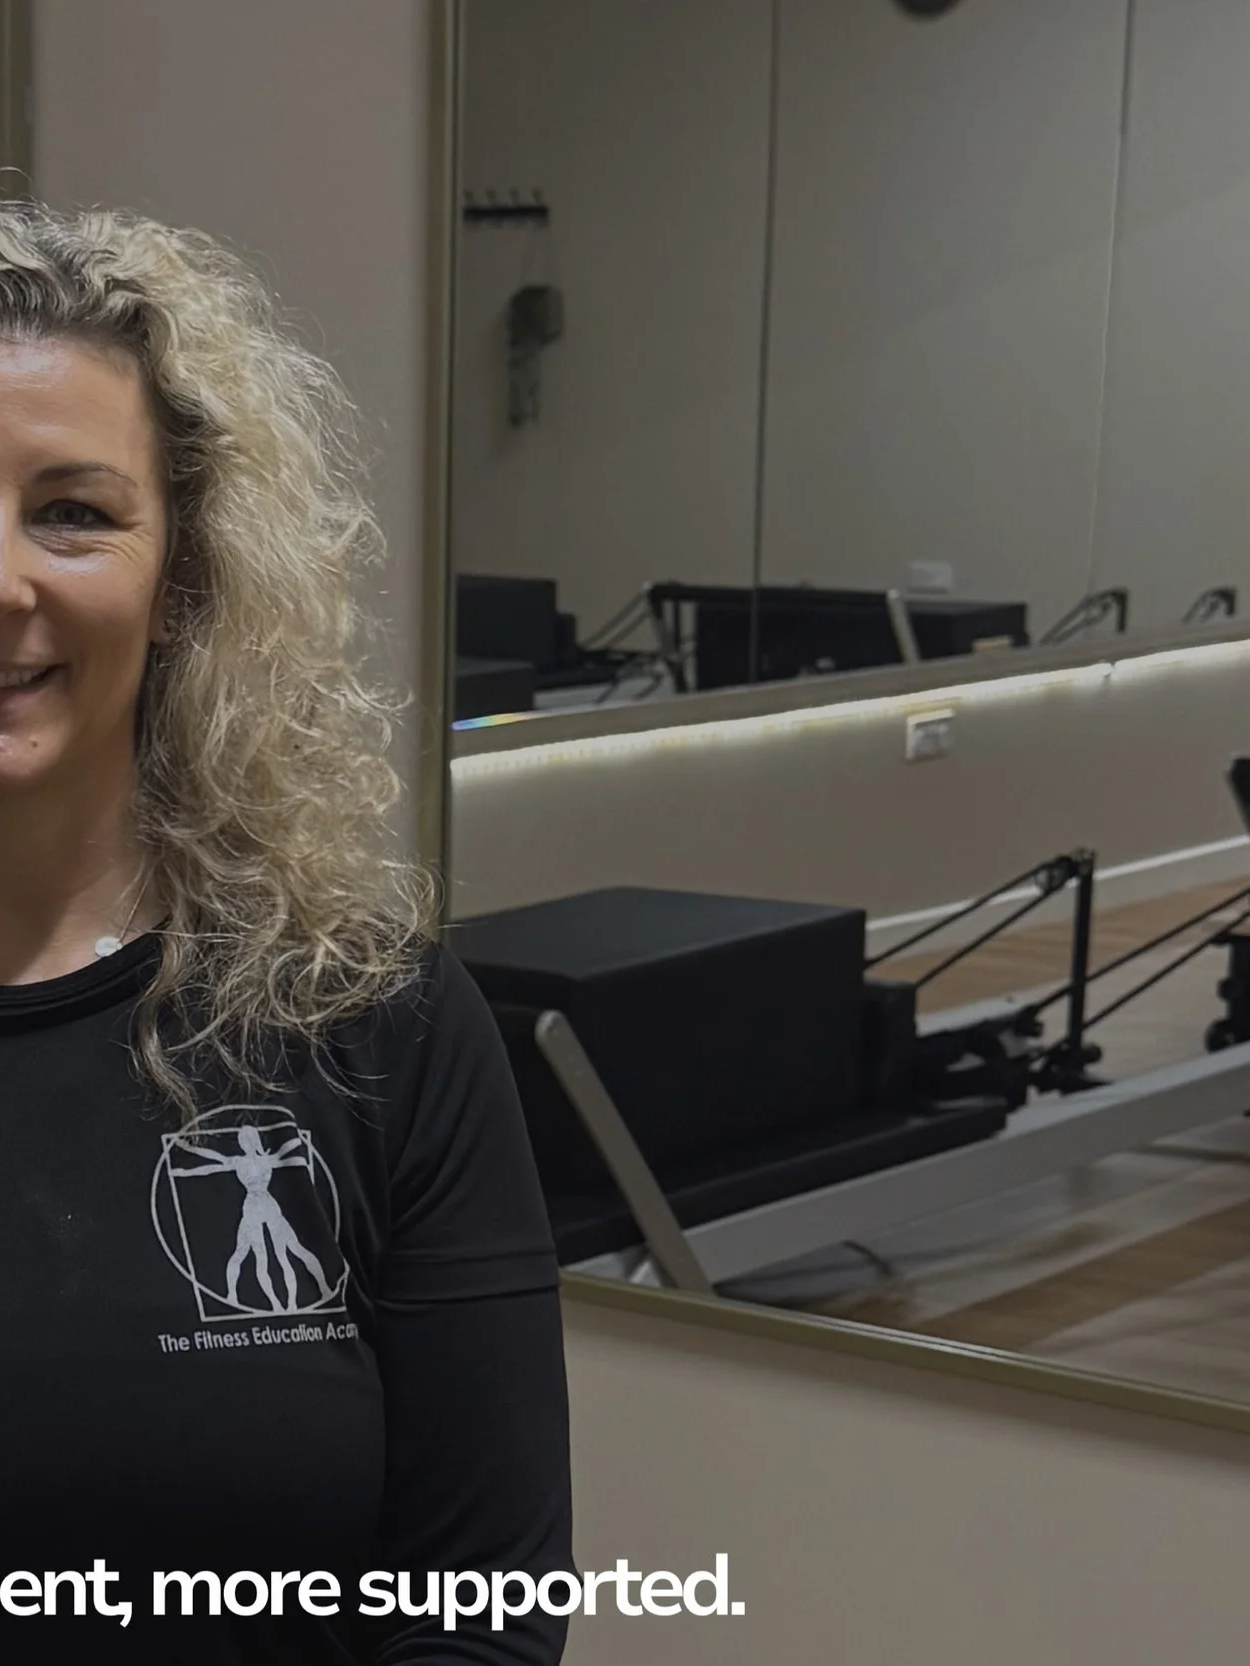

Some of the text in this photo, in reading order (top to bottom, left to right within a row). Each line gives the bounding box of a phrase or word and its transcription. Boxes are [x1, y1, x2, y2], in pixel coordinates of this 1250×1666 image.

[158, 1333, 190, 1353] The
[194, 1329, 250, 1350] Fitness
[251, 1323, 323, 1345] Education
